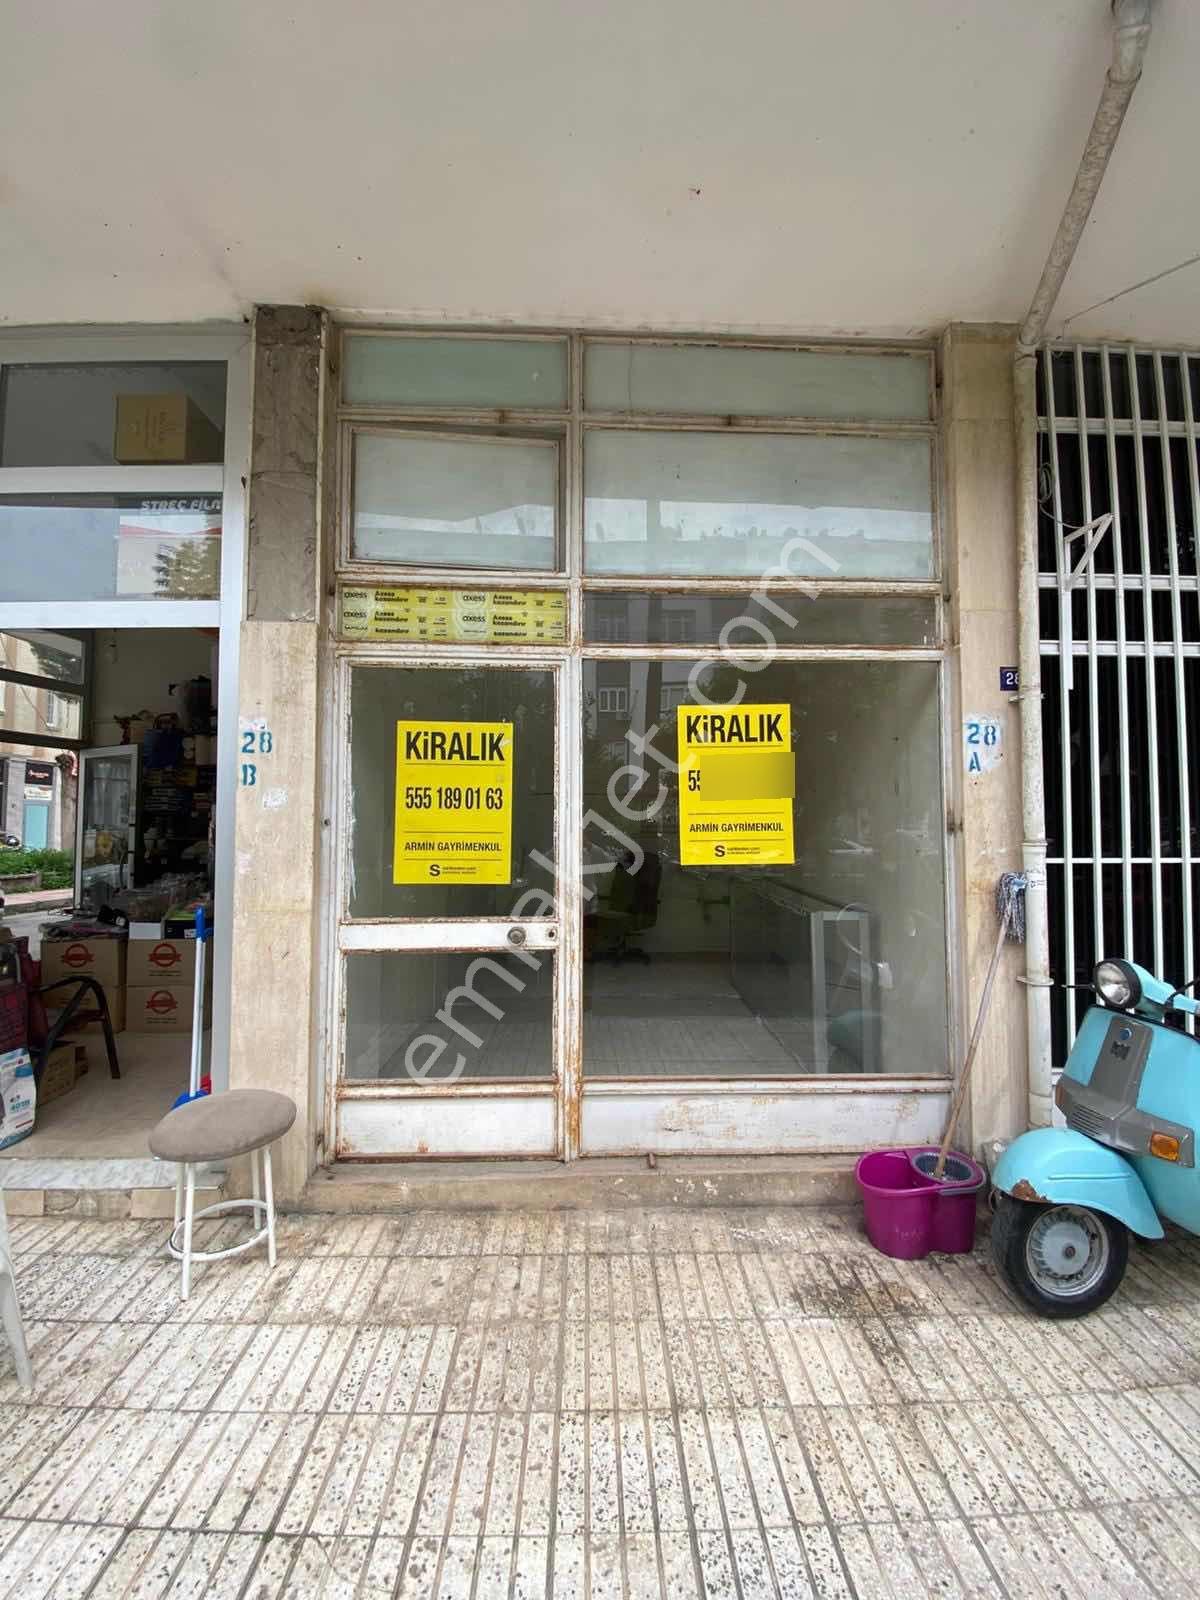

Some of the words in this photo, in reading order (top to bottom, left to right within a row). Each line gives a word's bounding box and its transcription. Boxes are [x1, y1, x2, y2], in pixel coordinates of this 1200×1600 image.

[241, 731, 273, 754] 28
[967, 723, 997, 746] 28
[968, 751, 982, 773] A
[241, 763, 257, 786] B
[405, 786, 432, 810] 555
[436, 787, 462, 810] 189
[465, 787, 481, 810] 01
[485, 787, 504, 810] 63
[689, 821, 719, 833] ARMİN
[721, 821, 784, 833] GAYRİMENKUL
[404, 840, 435, 852] ARMİN
[437, 840, 503, 852] GAYRİMENKUL
